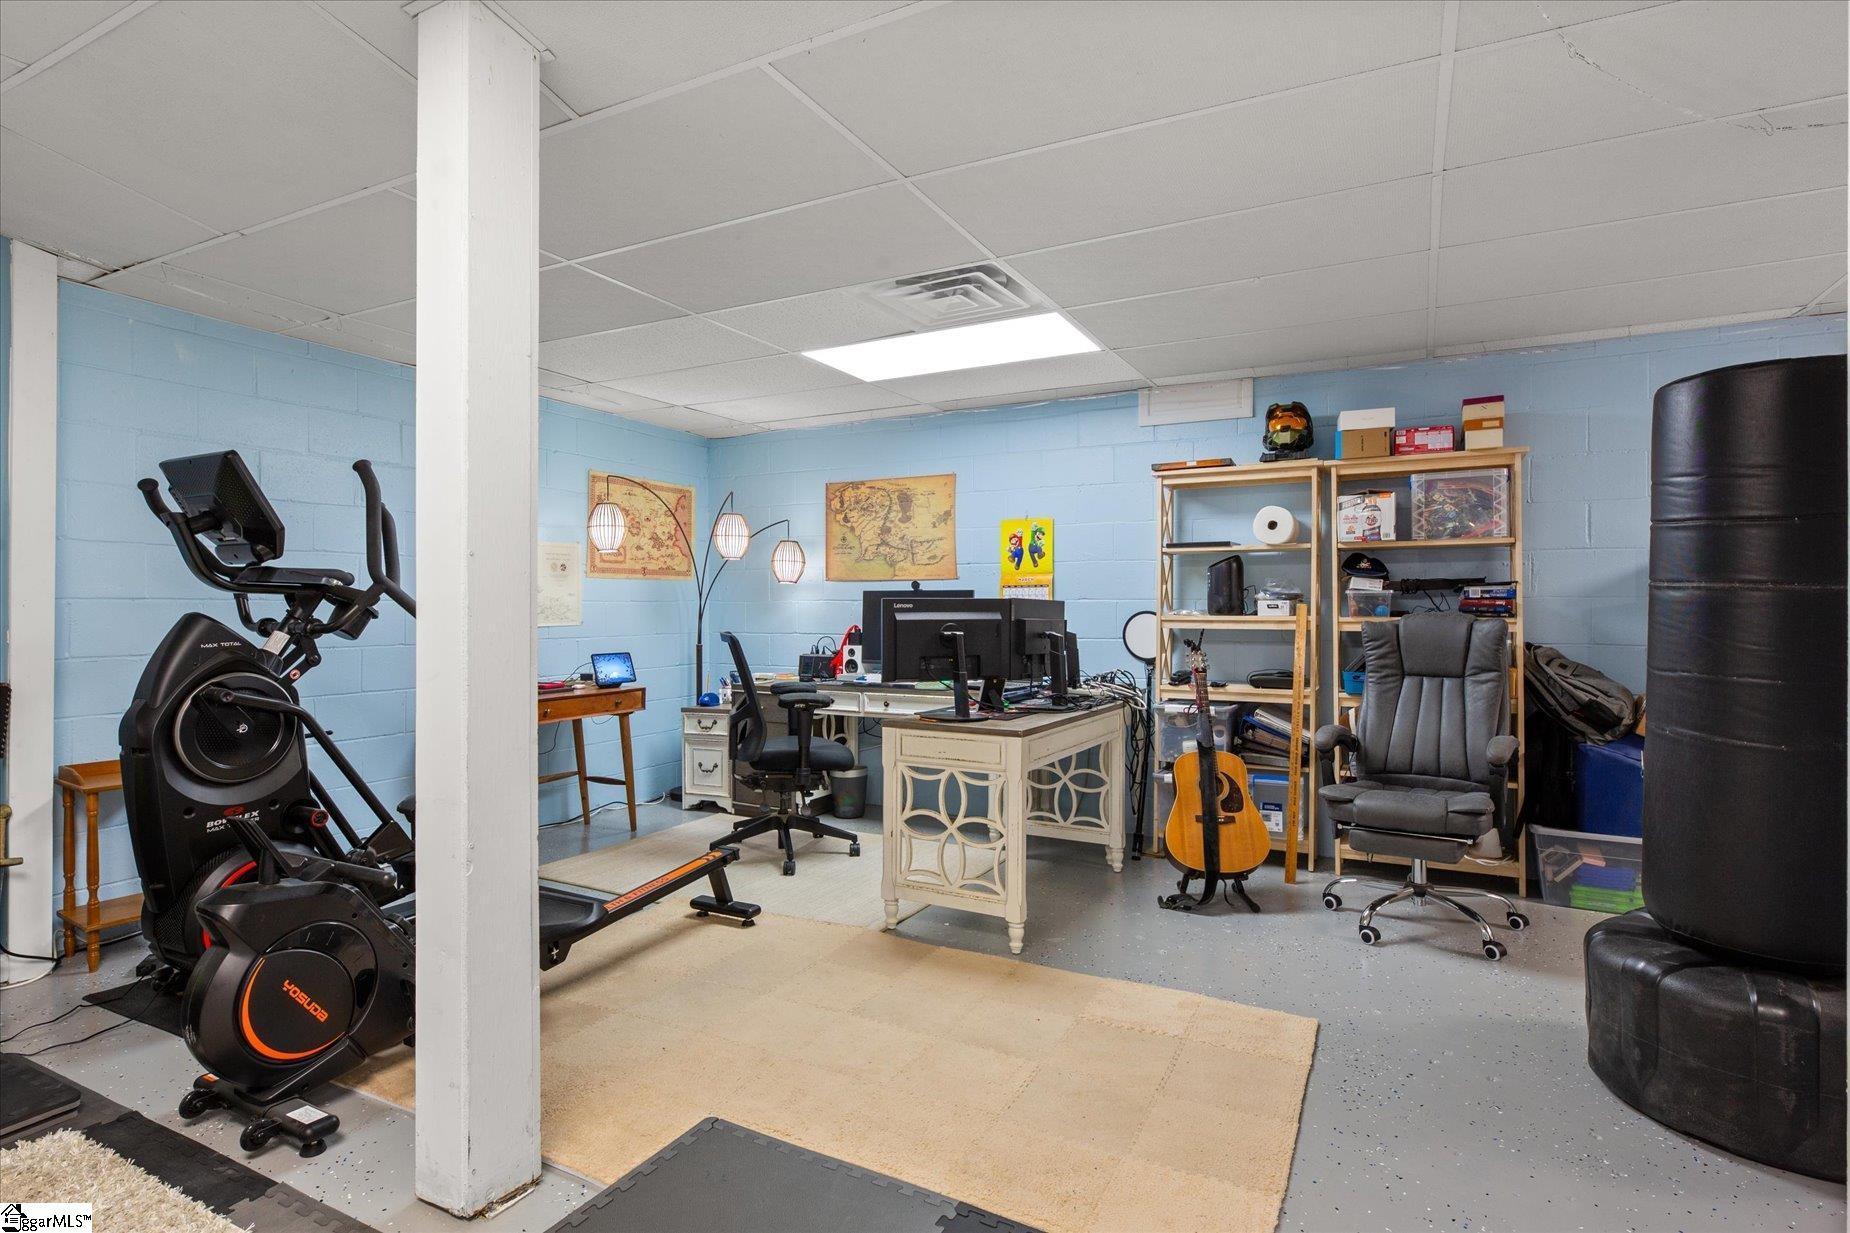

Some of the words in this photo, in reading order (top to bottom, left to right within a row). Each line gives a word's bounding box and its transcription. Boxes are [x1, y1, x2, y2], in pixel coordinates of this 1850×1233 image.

[206, 810, 260, 828] BOLEX
[206, 824, 225, 833] MAX
[282, 979, 329, 1023] YOSUDA
